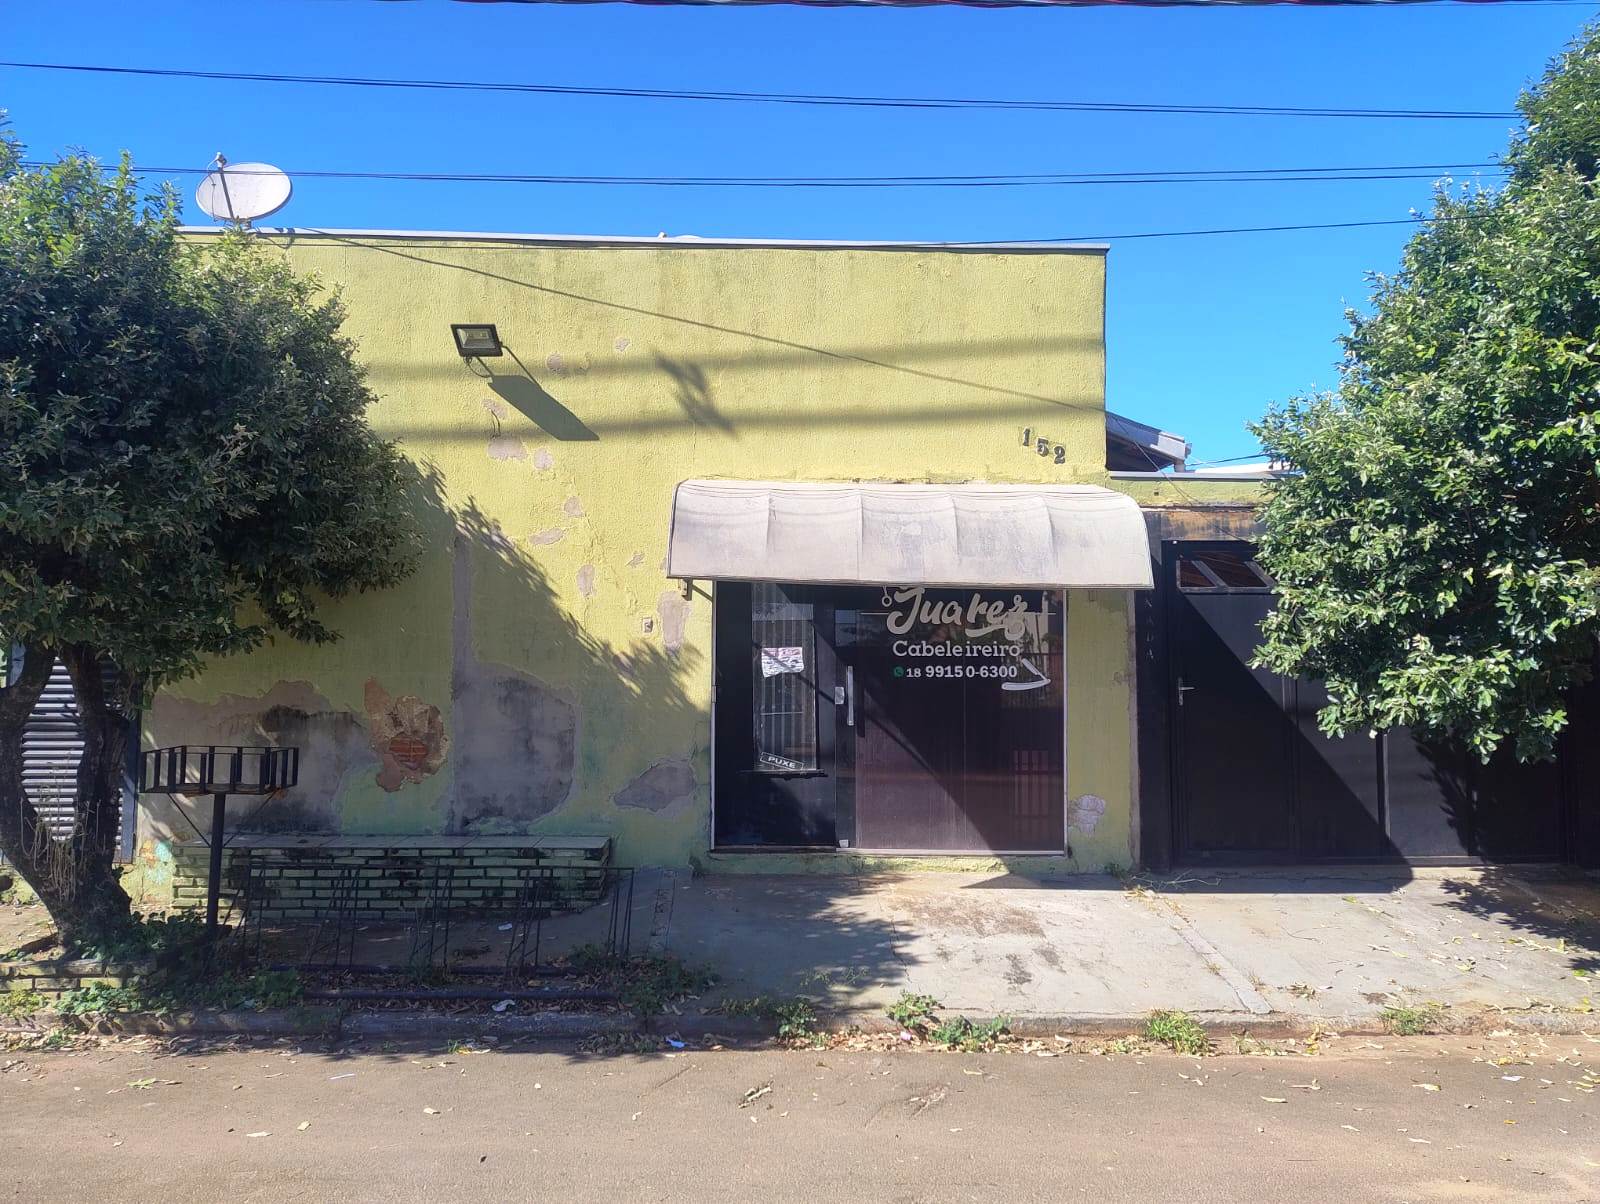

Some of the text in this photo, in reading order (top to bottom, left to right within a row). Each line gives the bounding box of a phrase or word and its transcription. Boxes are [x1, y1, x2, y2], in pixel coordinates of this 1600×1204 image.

[1023, 428, 1066, 464] 152
[887, 587, 1028, 641] Juarez
[893, 640, 1021, 657] Cabeleireiro
[906, 665, 1018, 678] 18 99150-6300
[768, 756, 796, 769] PUXE
